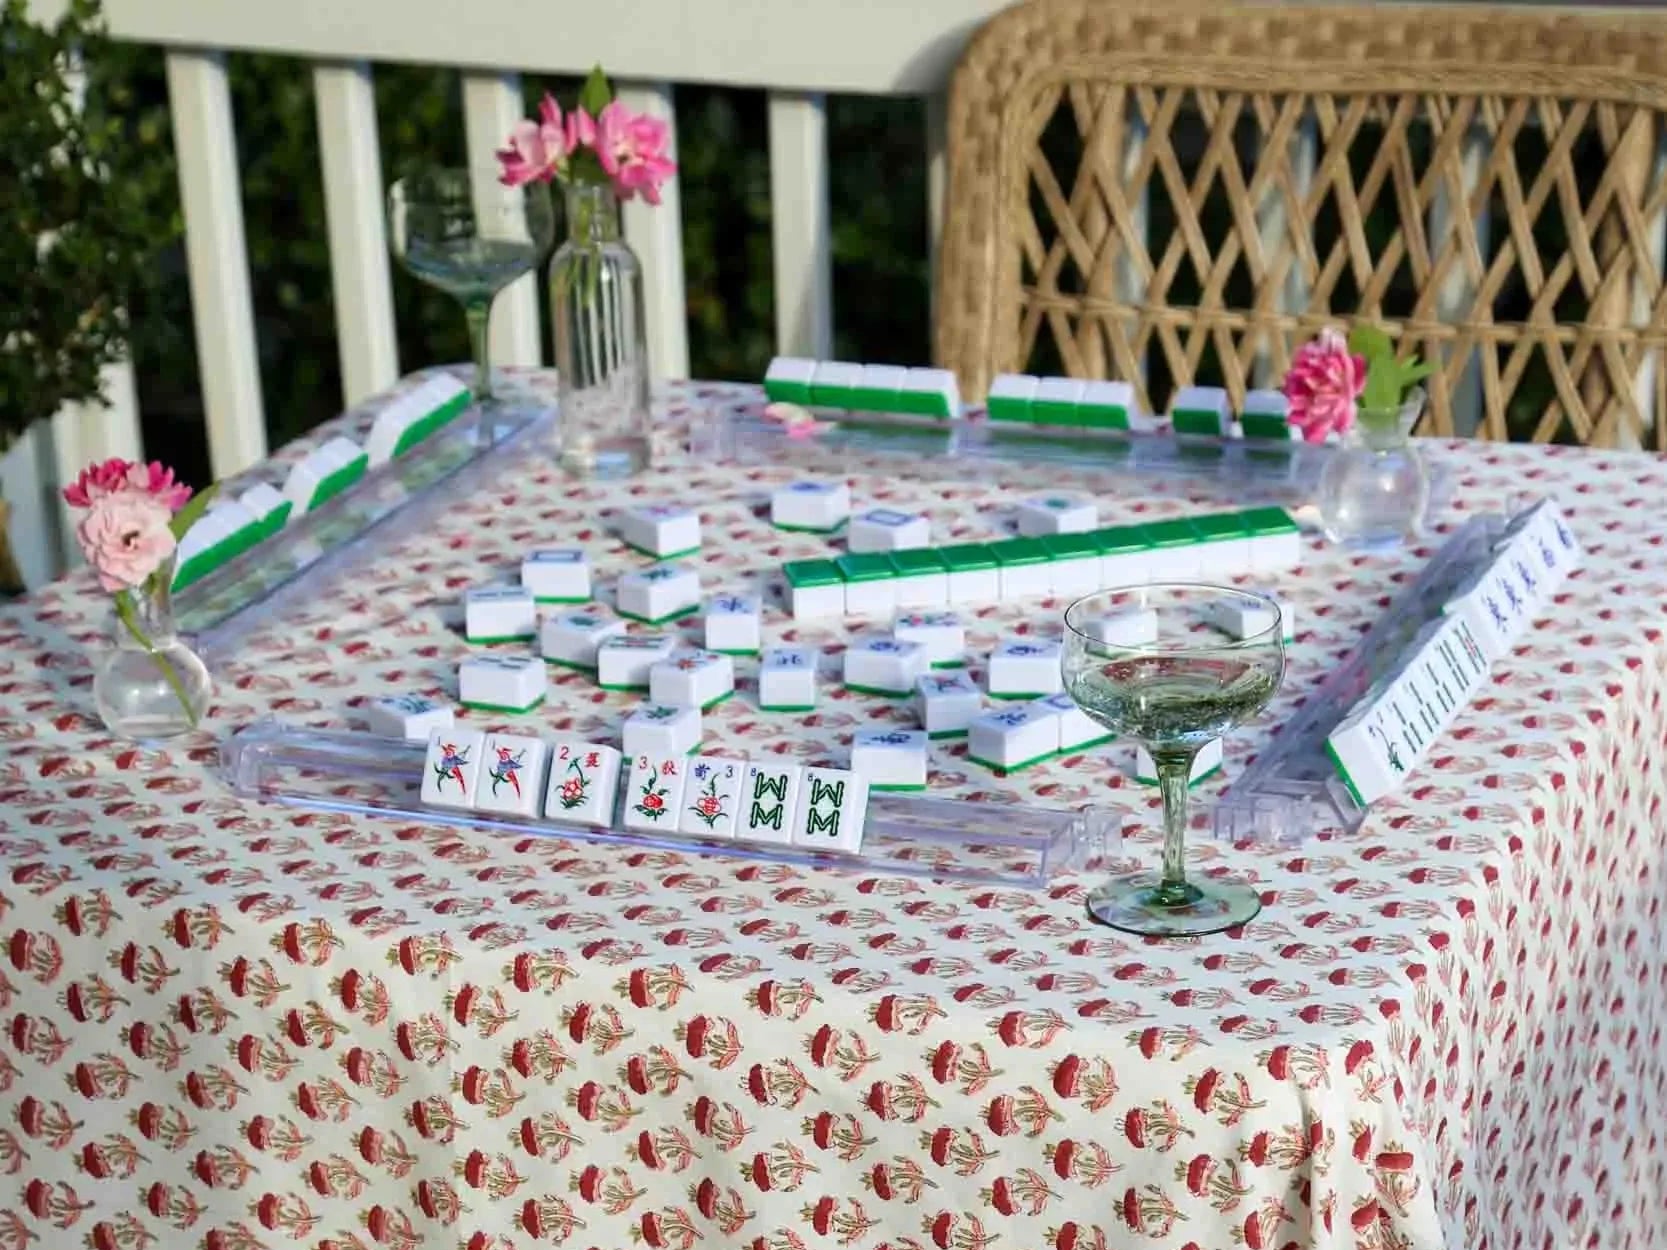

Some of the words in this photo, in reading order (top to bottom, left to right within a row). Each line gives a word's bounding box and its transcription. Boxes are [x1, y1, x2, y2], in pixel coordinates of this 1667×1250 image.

[559, 745, 569, 760] 2
[639, 756, 648, 770] 3
[725, 765, 733, 779] 3
